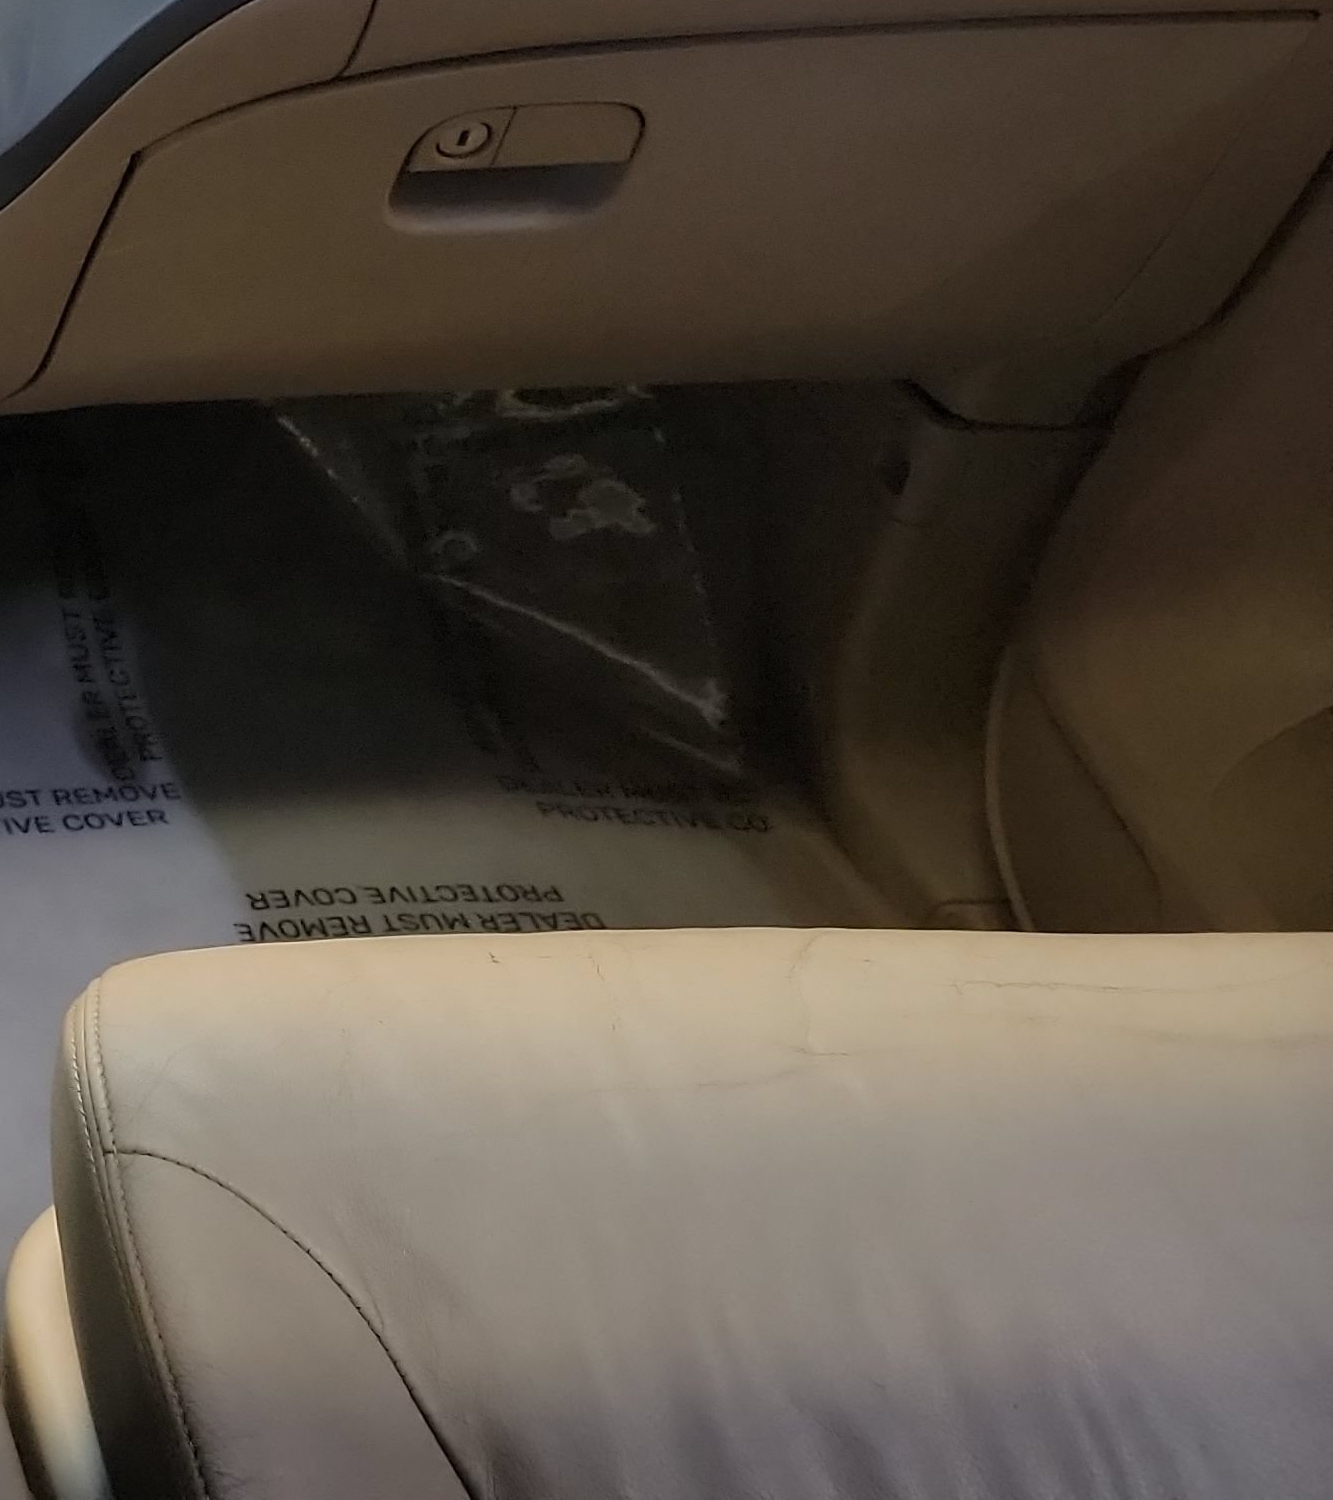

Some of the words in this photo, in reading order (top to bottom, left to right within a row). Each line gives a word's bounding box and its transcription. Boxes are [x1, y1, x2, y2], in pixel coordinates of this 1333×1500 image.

[53, 782, 183, 806] REMOVE
[62, 809, 169, 832] COVER
[247, 888, 357, 911] COVER
[373, 884, 565, 905] PROTECTIVE
[234, 915, 372, 942] REMOVE
[383, 913, 471, 934] MUST
[477, 911, 607, 932] DEALER
